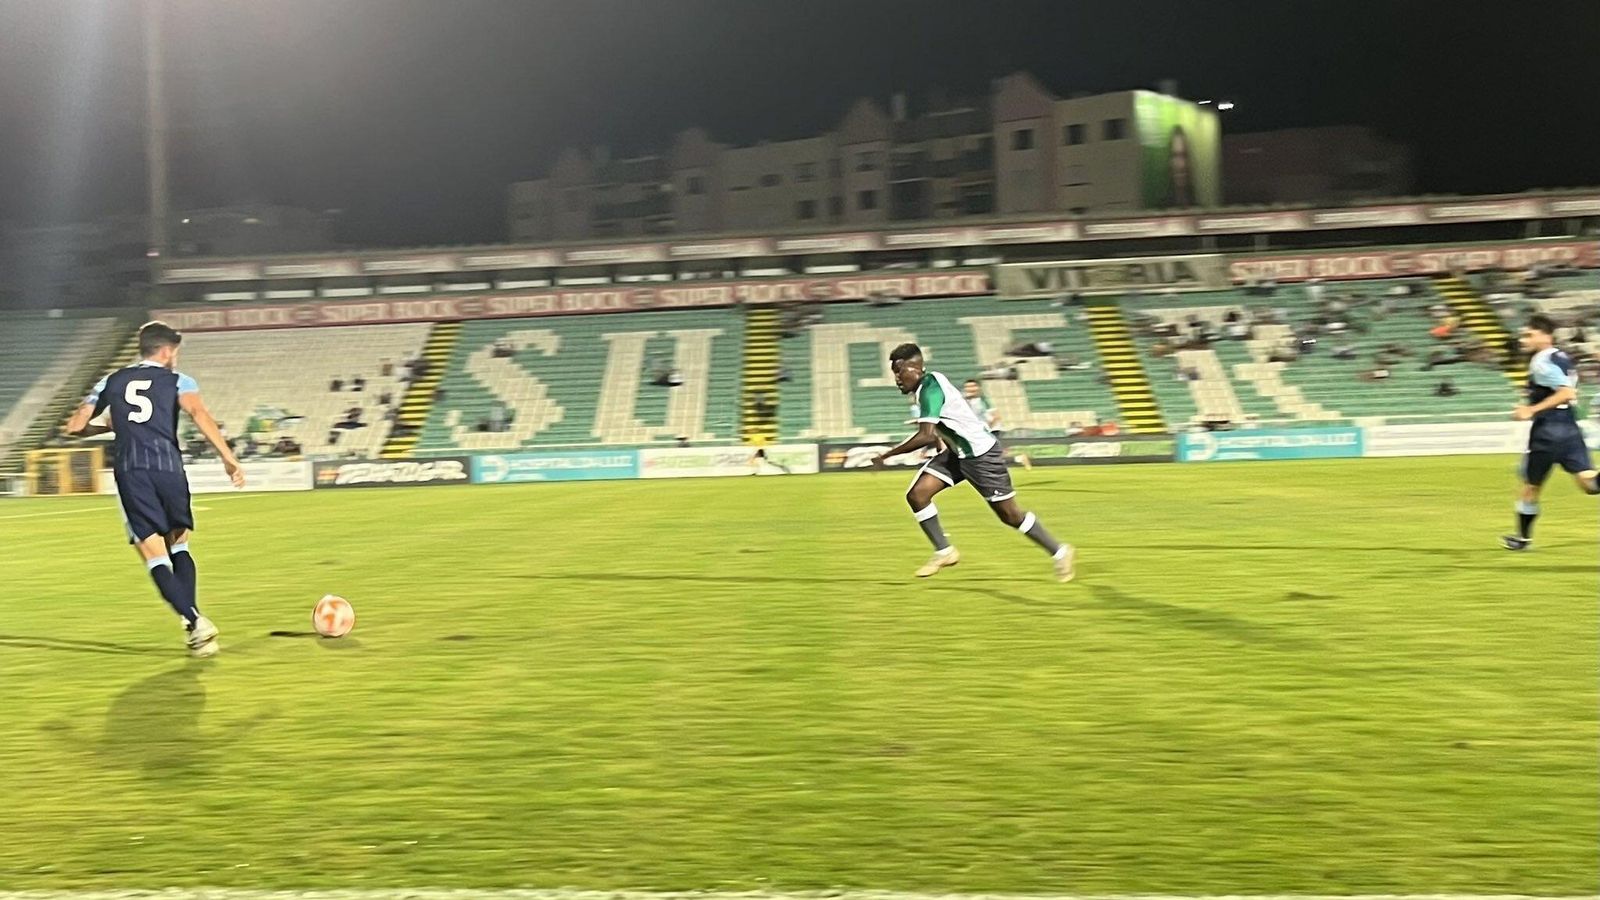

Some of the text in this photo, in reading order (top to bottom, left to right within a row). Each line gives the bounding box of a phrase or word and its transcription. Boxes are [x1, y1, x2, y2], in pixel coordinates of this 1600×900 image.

[1231, 257, 1390, 281] SUPER BOCK
[660, 283, 804, 307] SUPER BOCK
[838, 275, 988, 300] SUPER BOCK
[322, 300, 456, 323] SUPER BOCK
[487, 292, 625, 315] SUPER BOCK
[125, 380, 153, 423] 5
